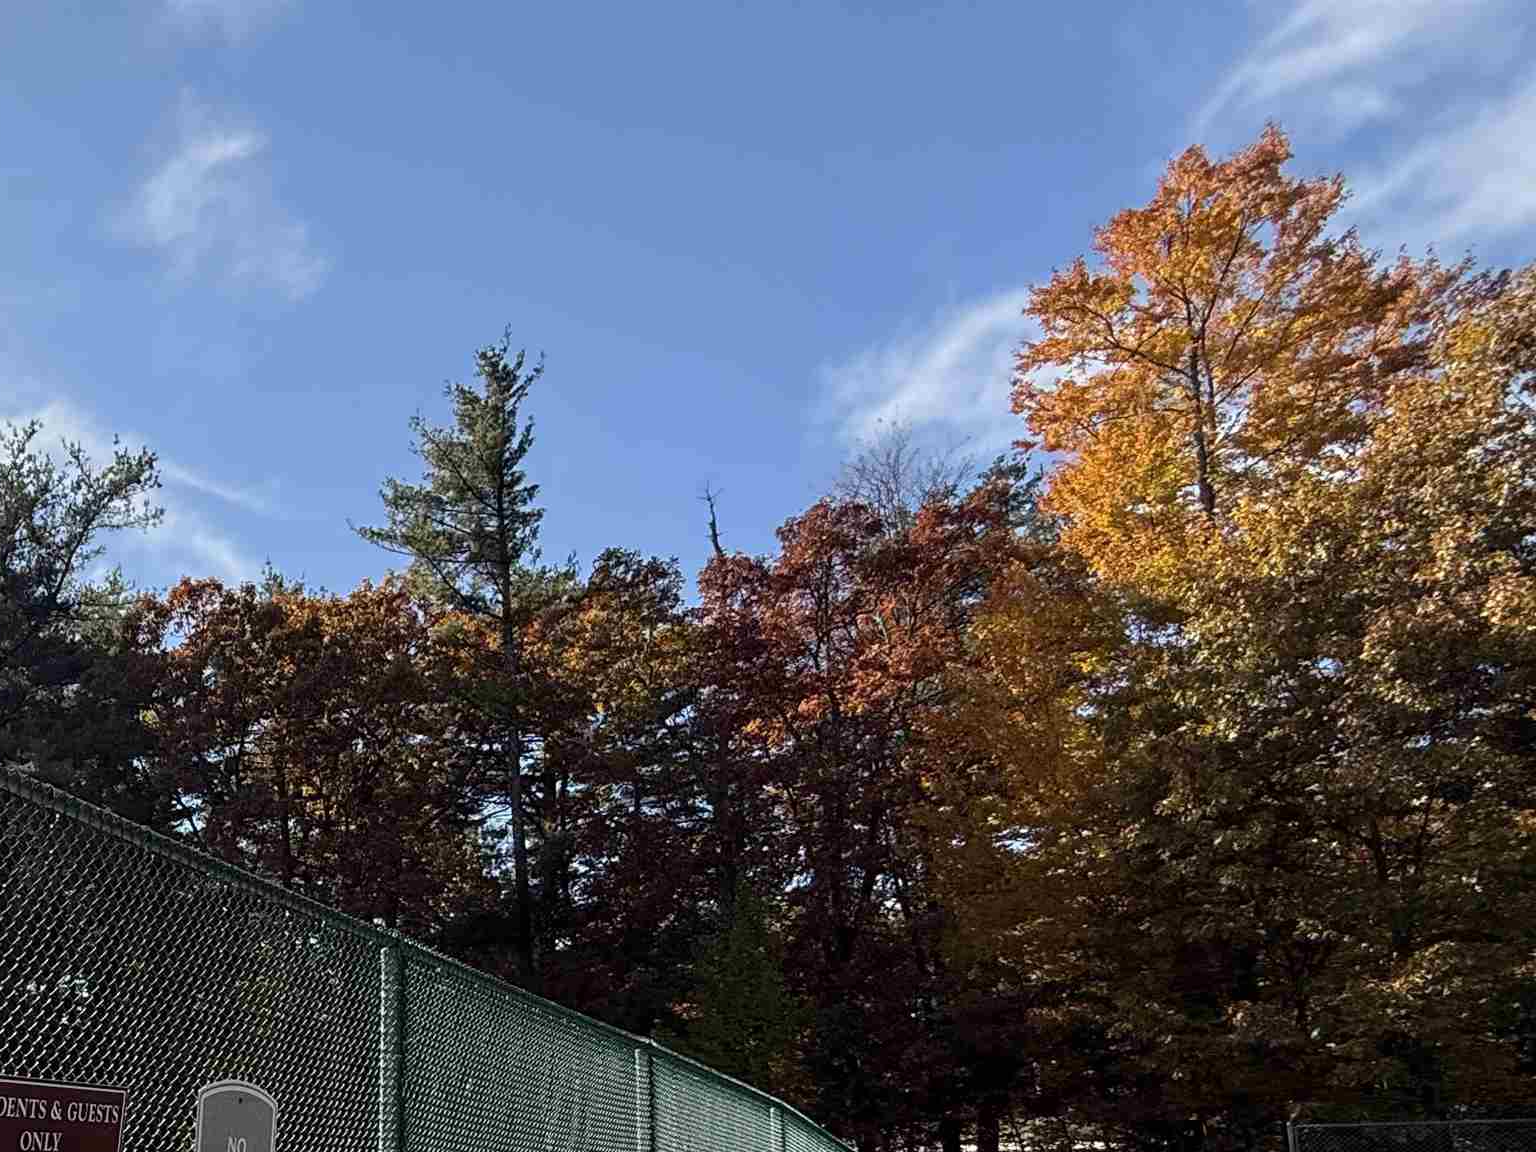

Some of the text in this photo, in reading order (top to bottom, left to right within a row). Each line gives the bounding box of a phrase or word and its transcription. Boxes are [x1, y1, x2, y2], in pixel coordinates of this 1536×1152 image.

[51, 1101, 62, 1121] &
[67, 1102, 119, 1123] GUESTS
[20, 1131, 63, 1152] ONLY
